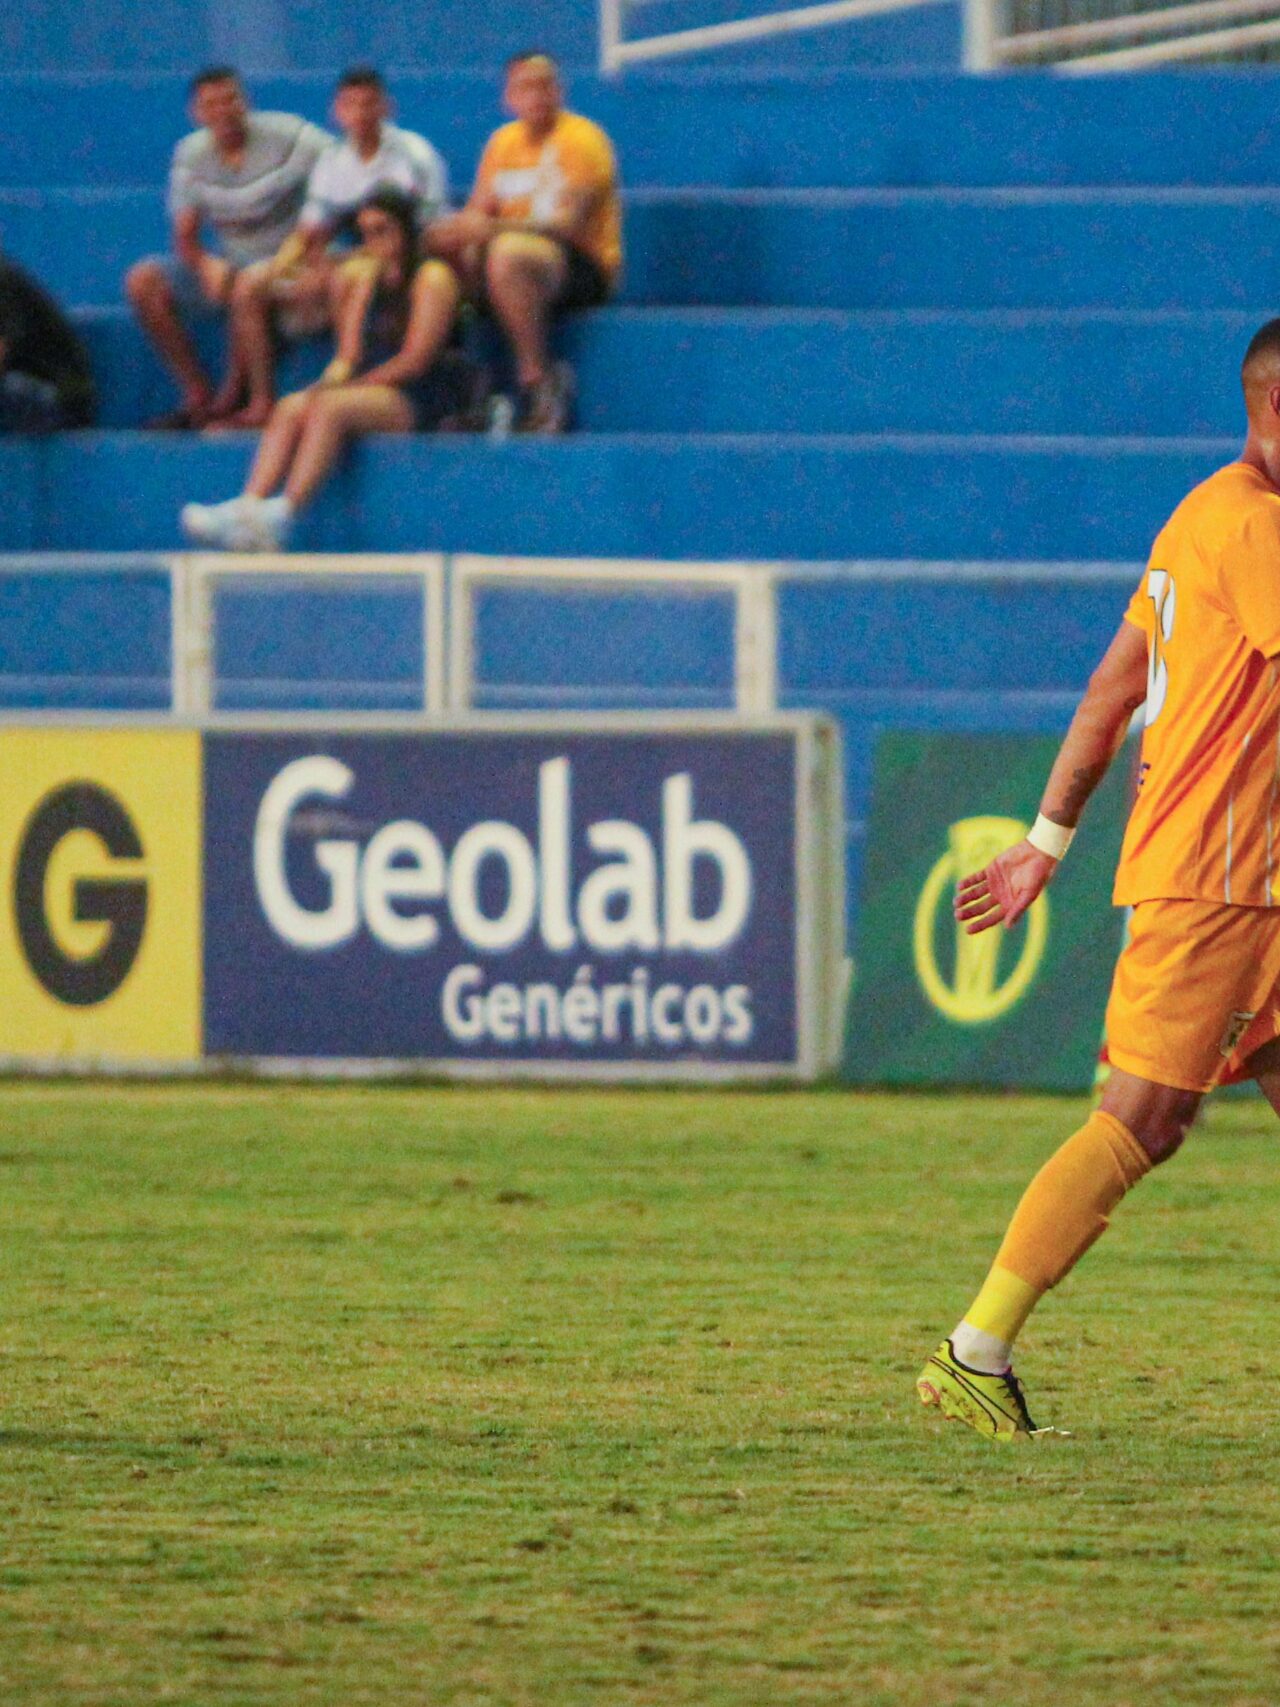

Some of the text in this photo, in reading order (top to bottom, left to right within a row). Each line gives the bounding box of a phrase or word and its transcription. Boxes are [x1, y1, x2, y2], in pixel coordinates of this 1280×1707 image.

[12, 779, 150, 1009] G
[253, 754, 753, 952] Geolab
[442, 963, 753, 1044] Genéricos
